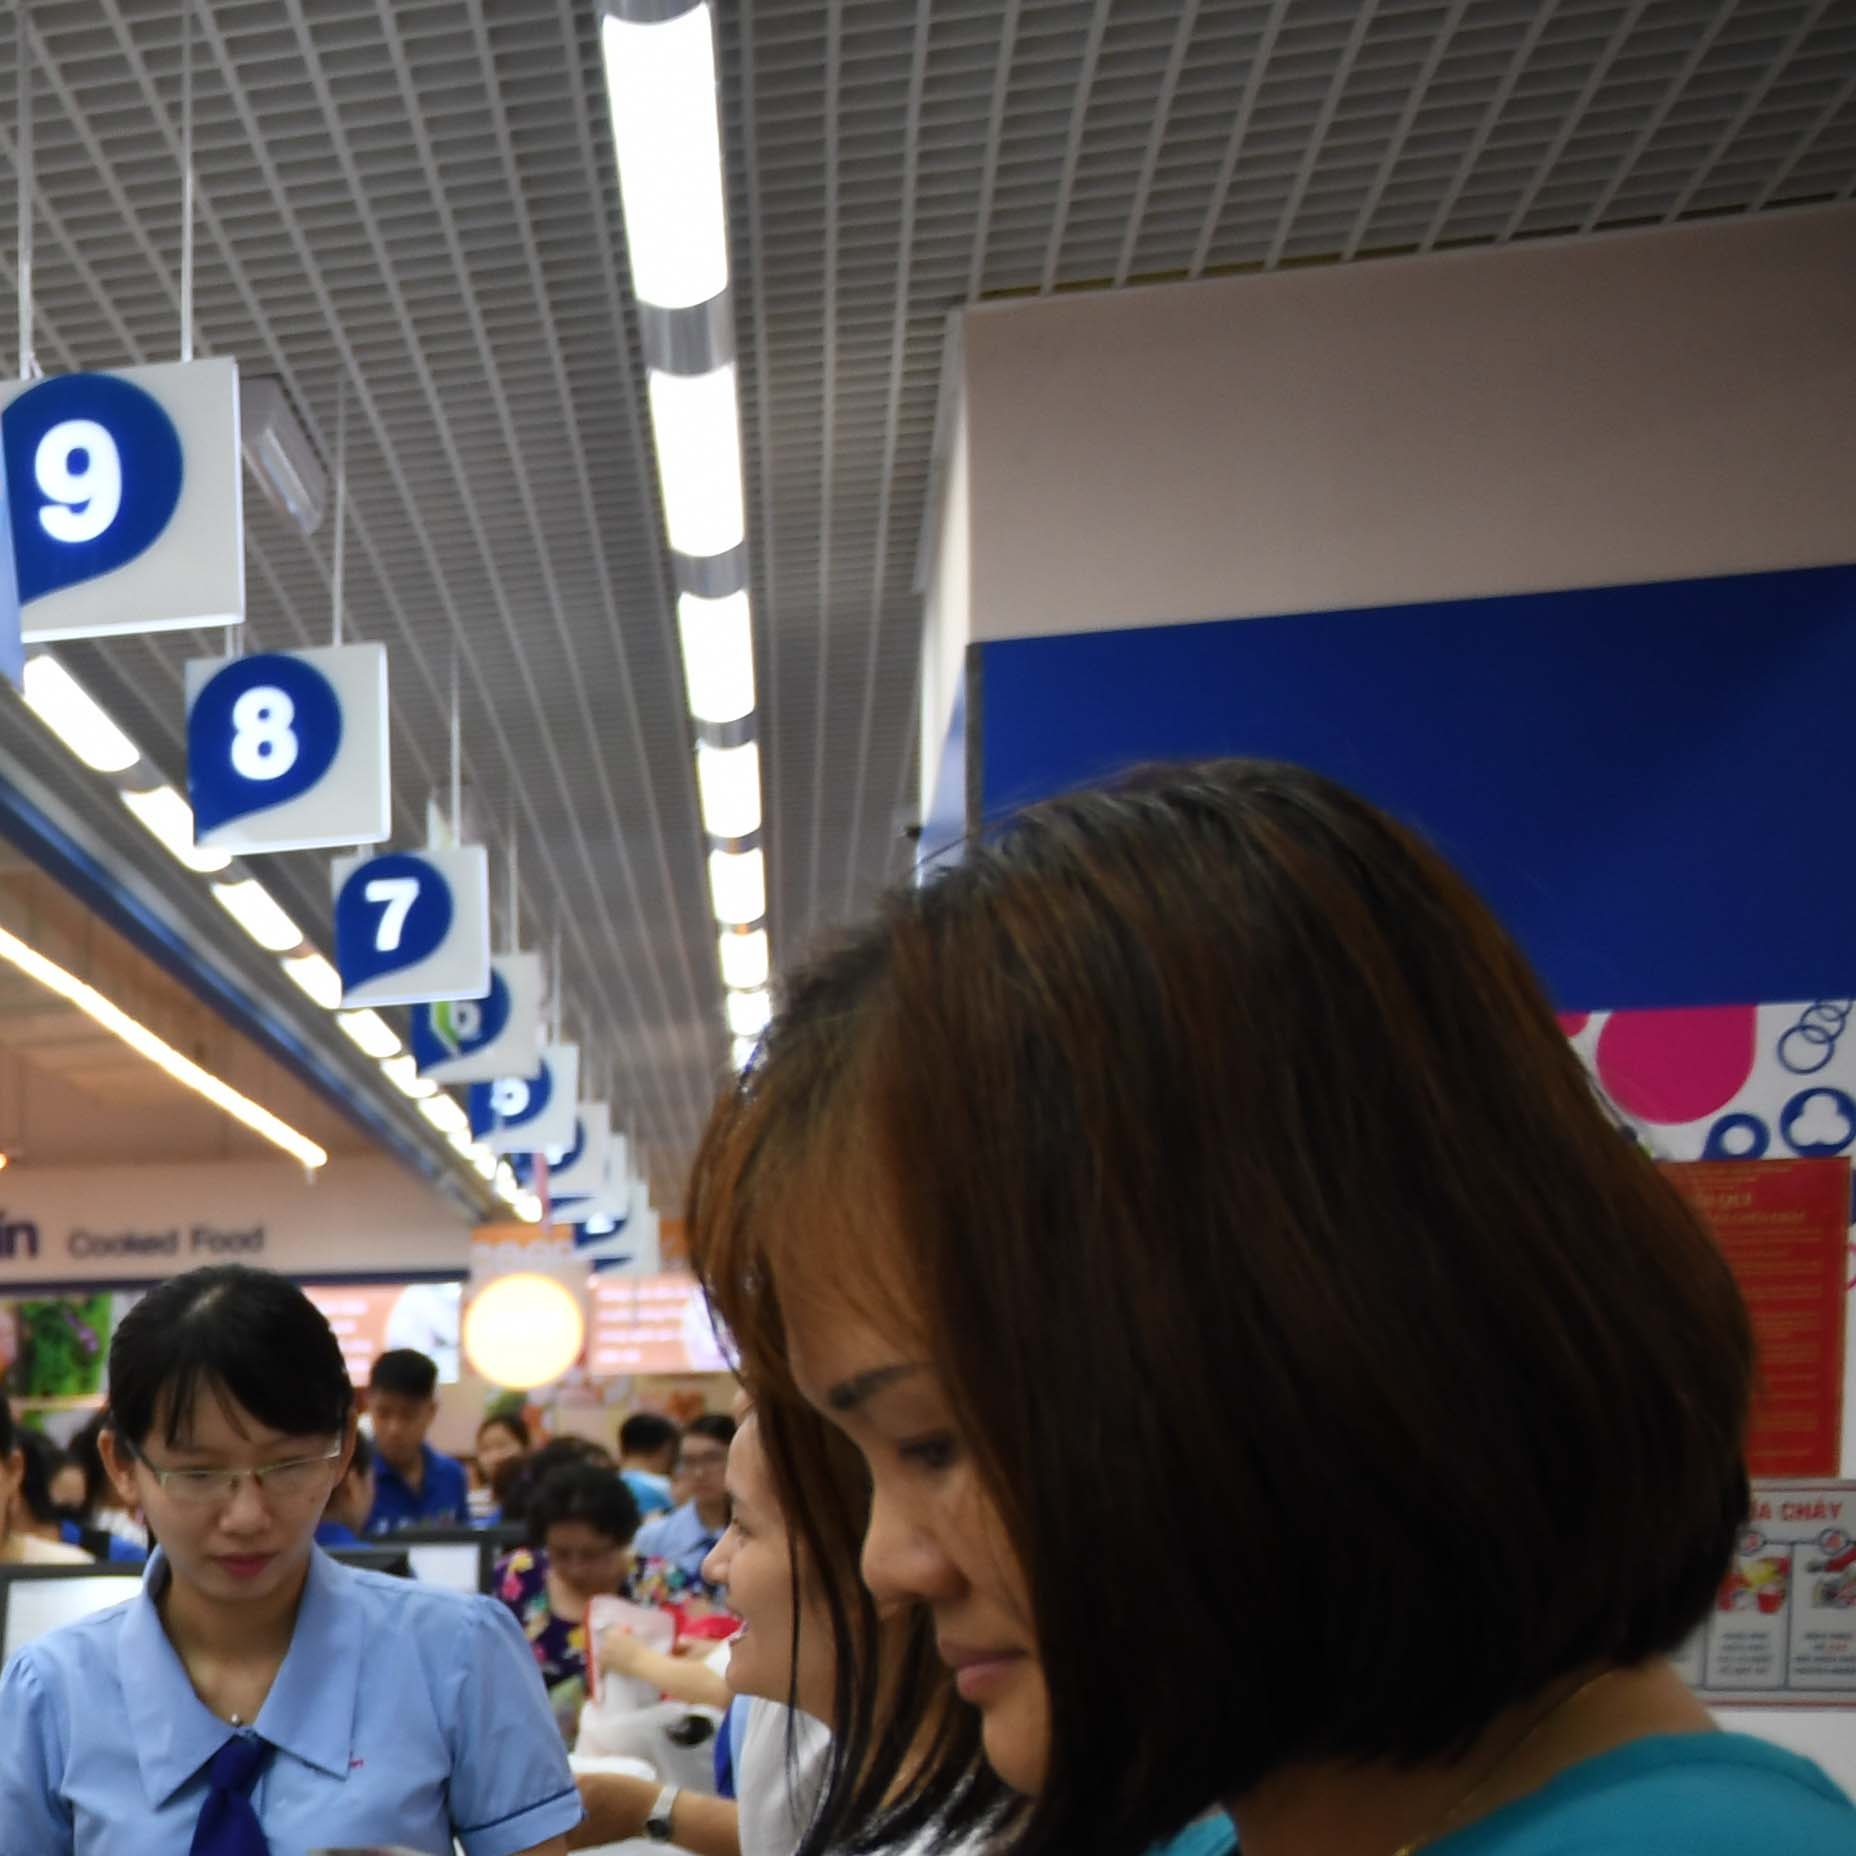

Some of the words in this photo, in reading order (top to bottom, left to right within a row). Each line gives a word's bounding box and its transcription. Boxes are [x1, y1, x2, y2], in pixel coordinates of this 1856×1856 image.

[33, 419, 124, 544] 9
[230, 684, 299, 781] 8
[363, 877, 421, 952] 7
